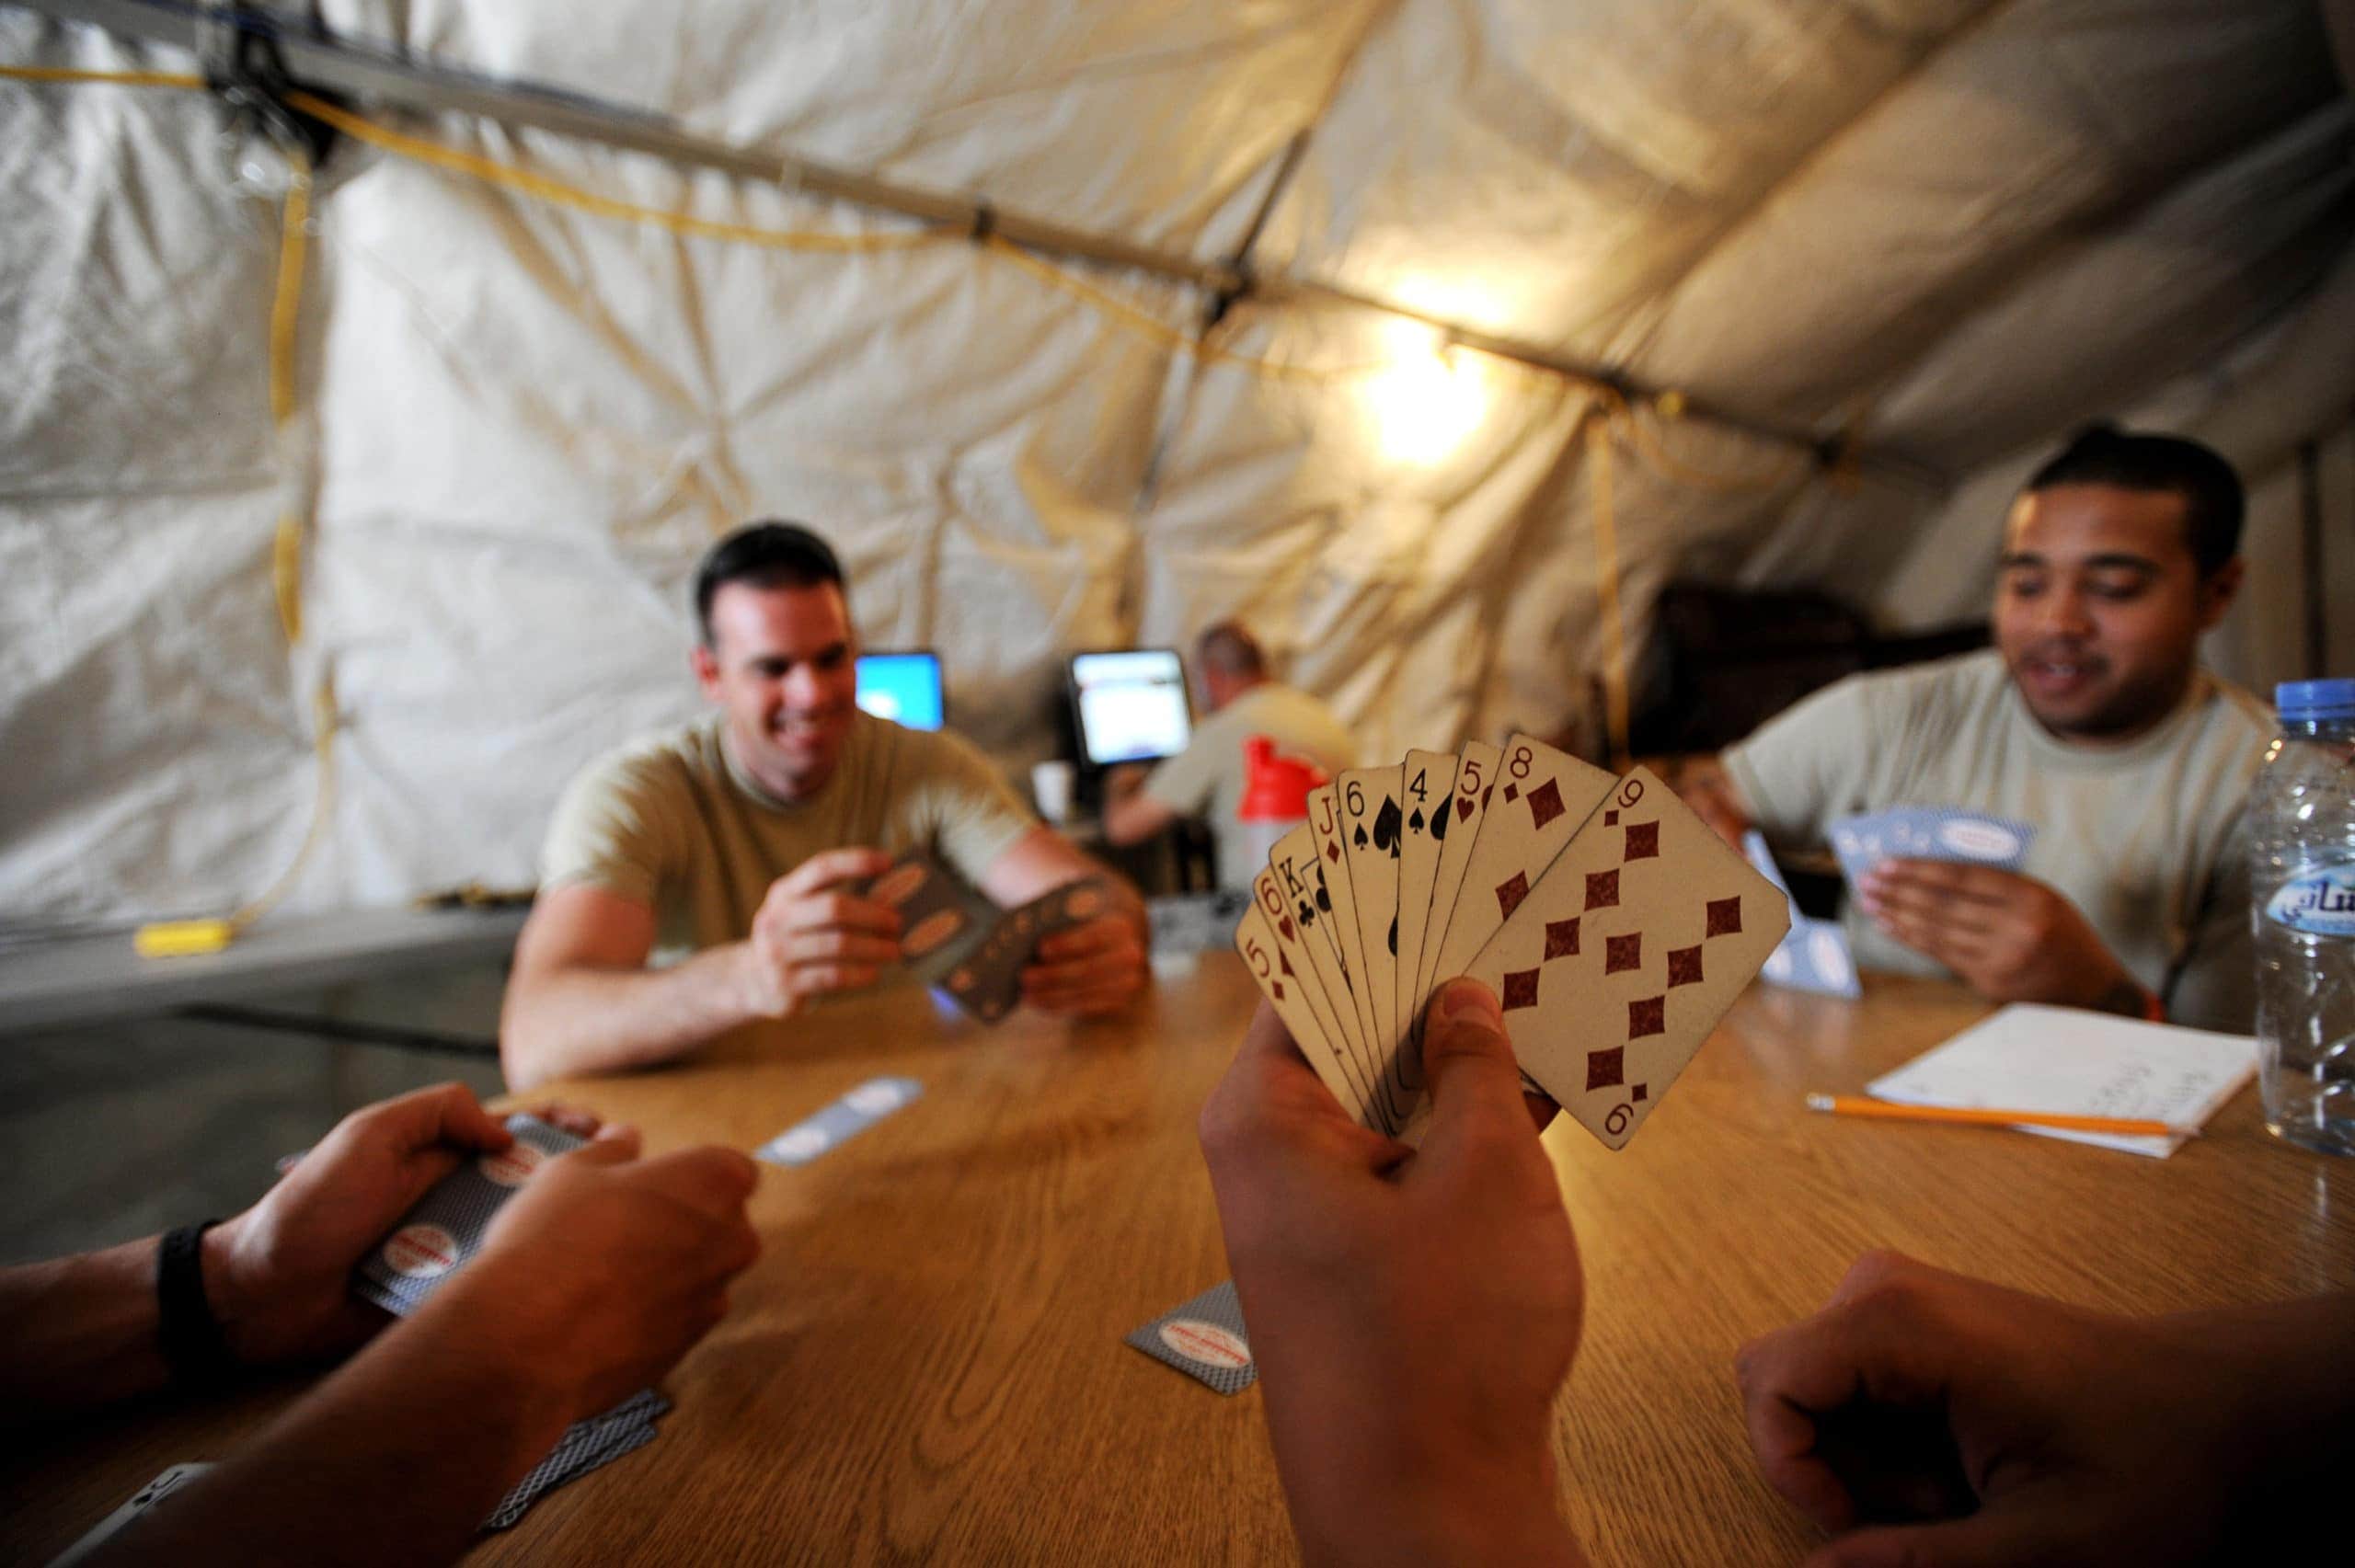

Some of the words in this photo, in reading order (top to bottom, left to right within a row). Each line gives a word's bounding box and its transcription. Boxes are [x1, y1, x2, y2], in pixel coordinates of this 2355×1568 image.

[1461, 760, 1481, 795] 5
[1510, 747, 1533, 779] 8
[1346, 781, 1365, 817] 6
[1409, 768, 1428, 802] 4
[1617, 779, 1644, 808] 9
[1318, 795, 1334, 835] J
[1279, 856, 1304, 898] K
[1260, 876, 1283, 916] 6
[1246, 938, 1270, 979] 5
[1605, 1104, 1634, 1135] 9
